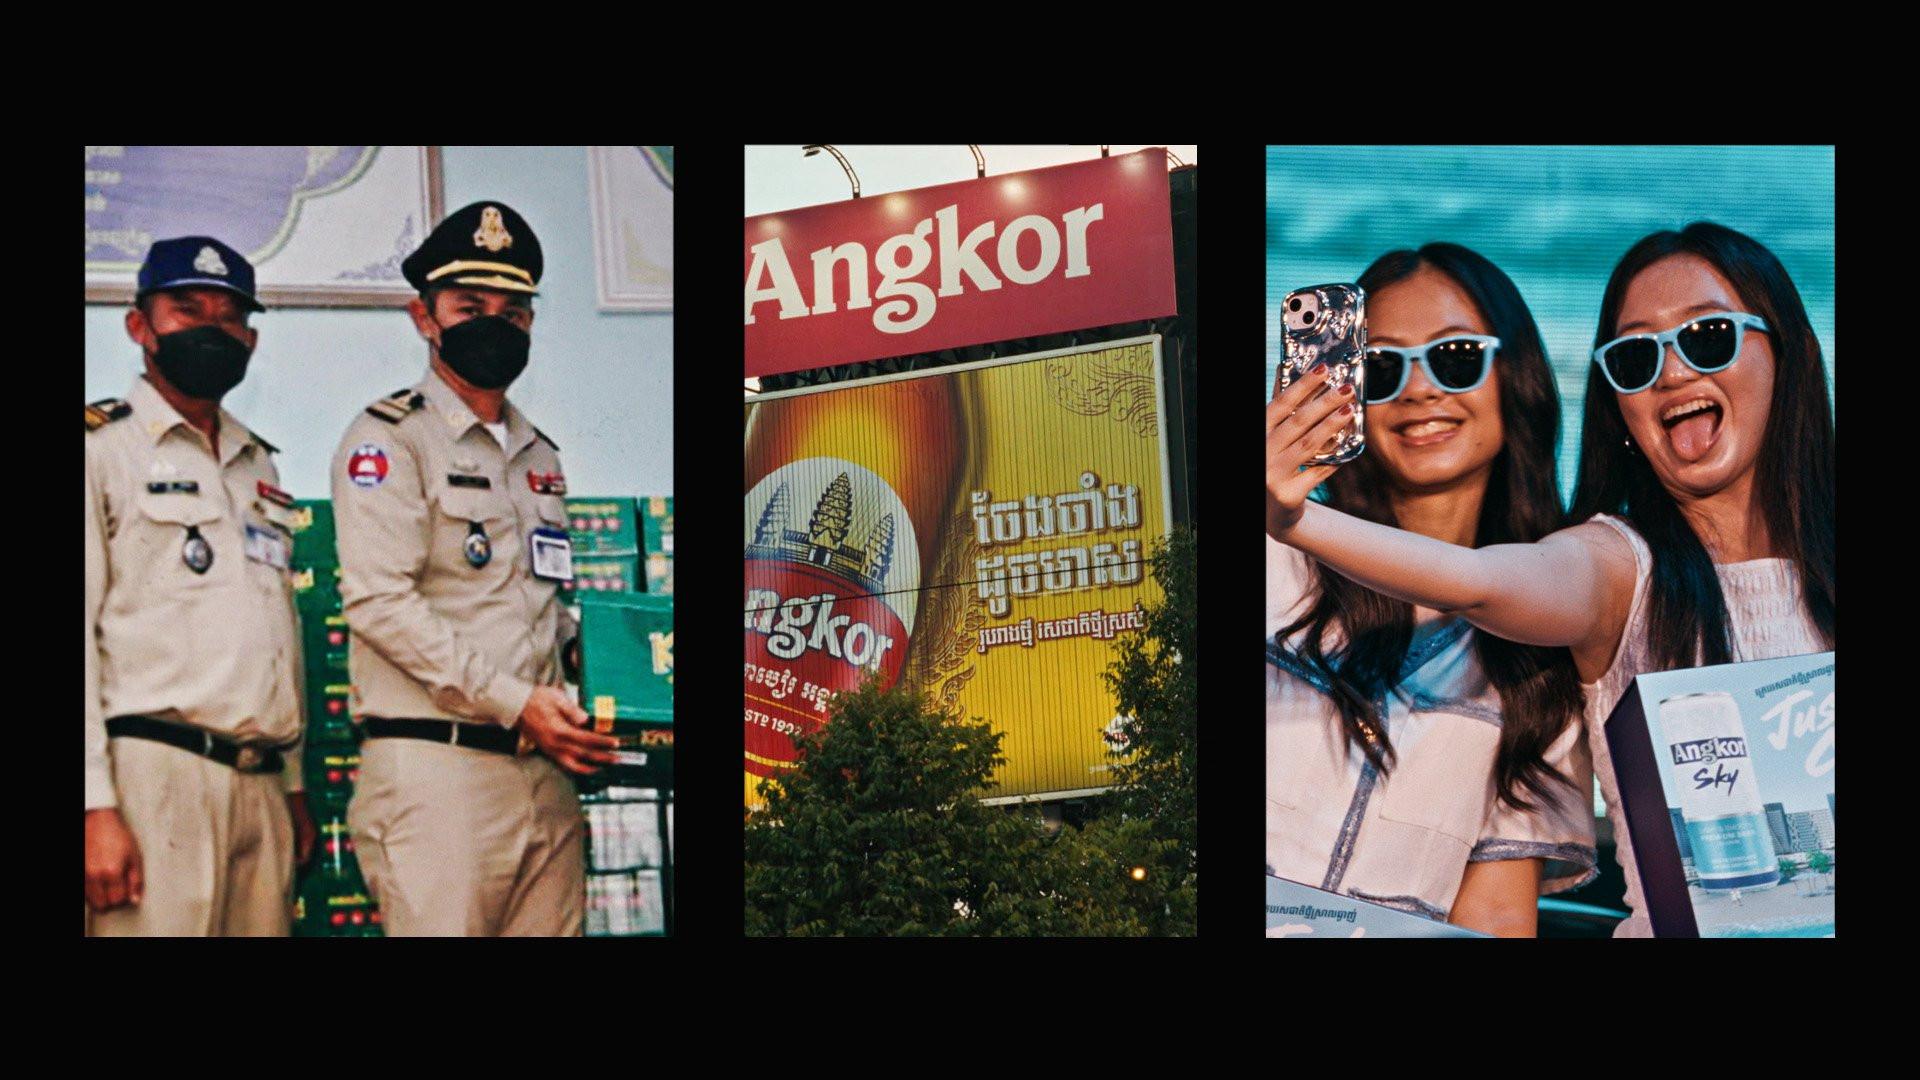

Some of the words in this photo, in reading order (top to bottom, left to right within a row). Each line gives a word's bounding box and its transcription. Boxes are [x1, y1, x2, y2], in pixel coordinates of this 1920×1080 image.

[744, 203, 1104, 334] Angkor
[1675, 737, 1745, 765] Angkor
[1693, 763, 1739, 796] Sky
